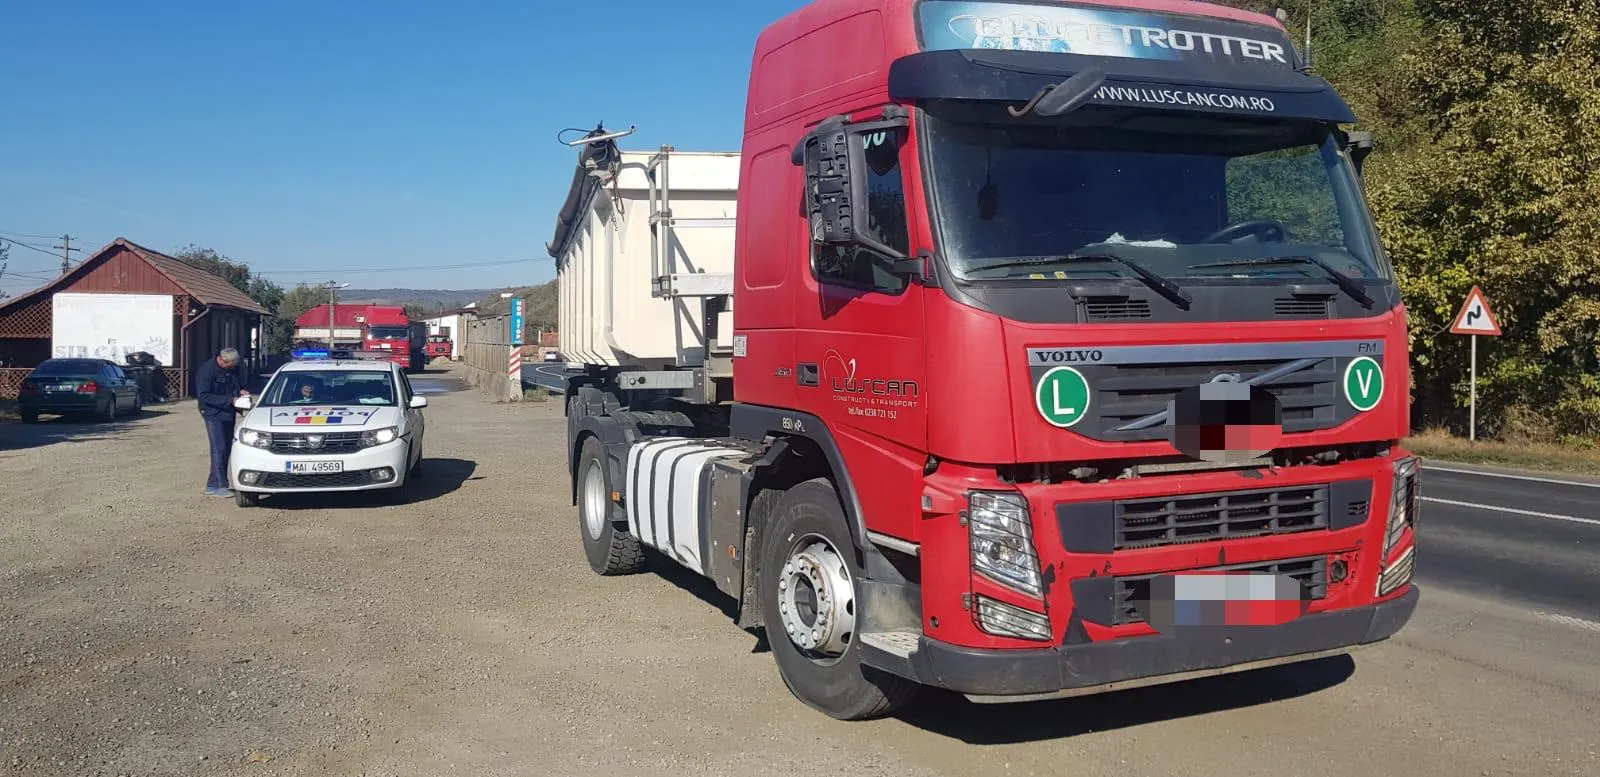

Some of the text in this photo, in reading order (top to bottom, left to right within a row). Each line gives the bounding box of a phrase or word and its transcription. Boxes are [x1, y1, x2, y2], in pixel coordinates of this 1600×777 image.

[1358, 342, 1377, 353] FM
[1035, 350, 1103, 362] VOLVO
[1356, 368, 1373, 399] V
[1052, 379, 1075, 415] L
[292, 462, 340, 472] MAI 49569
